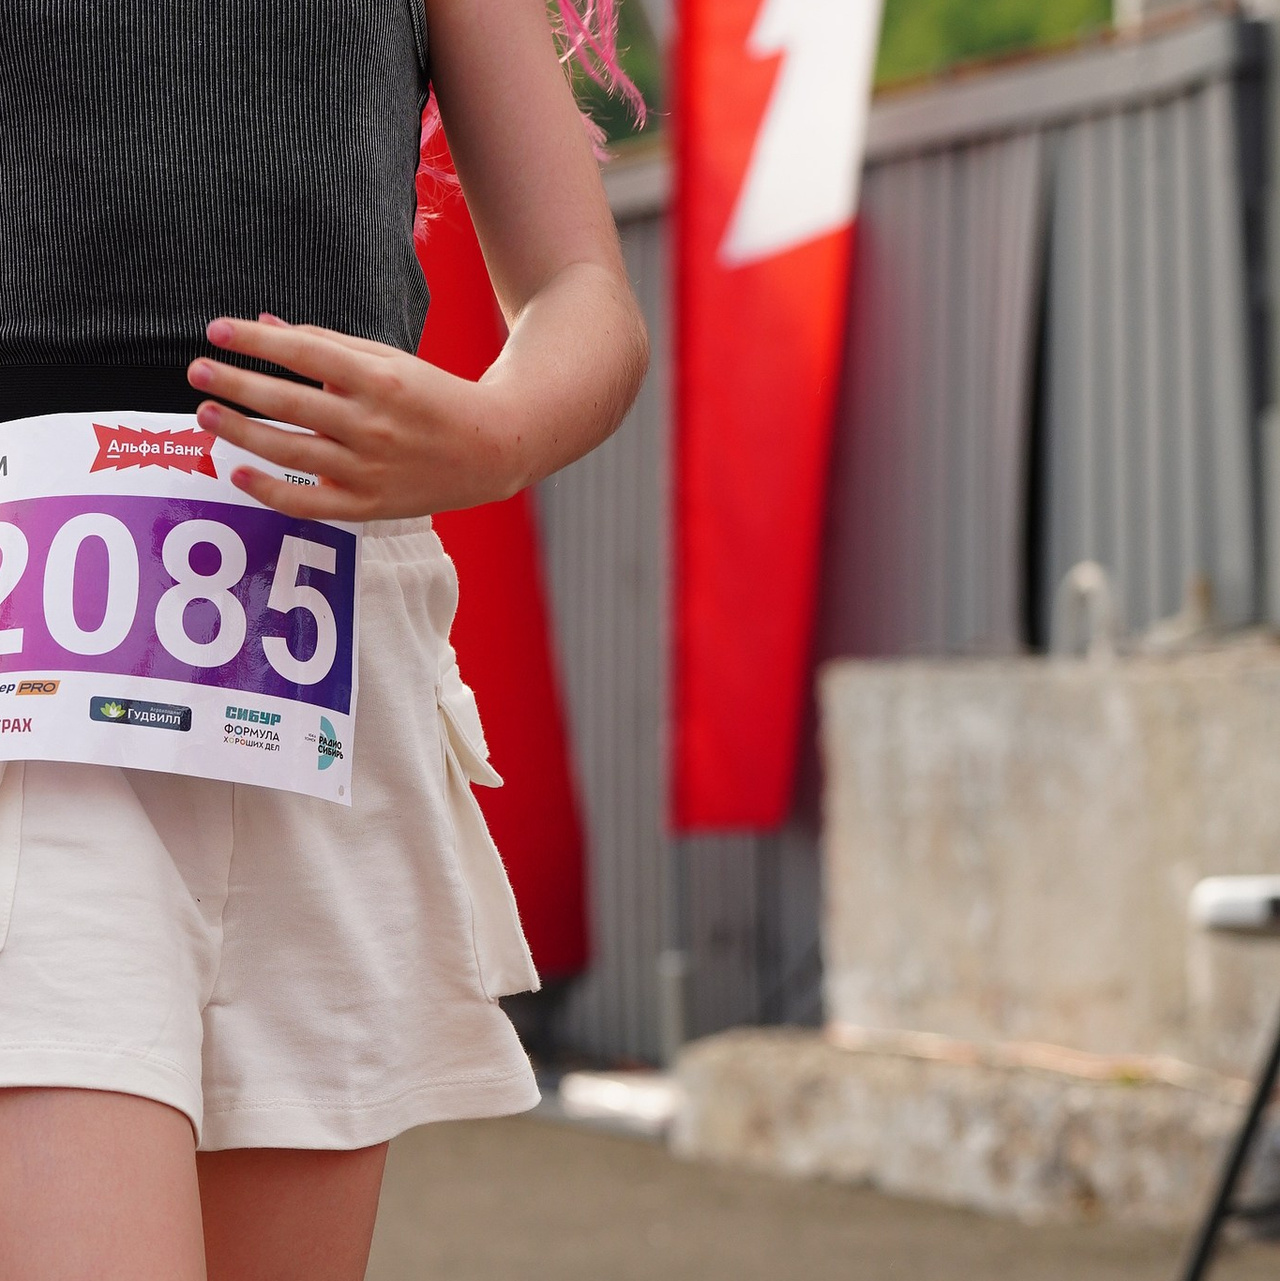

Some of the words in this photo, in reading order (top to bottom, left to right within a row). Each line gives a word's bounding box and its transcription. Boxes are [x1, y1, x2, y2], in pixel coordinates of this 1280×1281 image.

[106, 438, 160, 457] Альфа
[163, 440, 204, 458] Банк
[18, 681, 57, 694] PRO
[225, 705, 282, 726] СИБУР
[224, 723, 280, 742] ФОРМУЛА
[223, 736, 264, 749] ХОРОШИХ
[265, 742, 280, 752] ДЕЛ
[318, 735, 342, 750] РАДИО
[317, 744, 344, 760] СИБИРЬ
